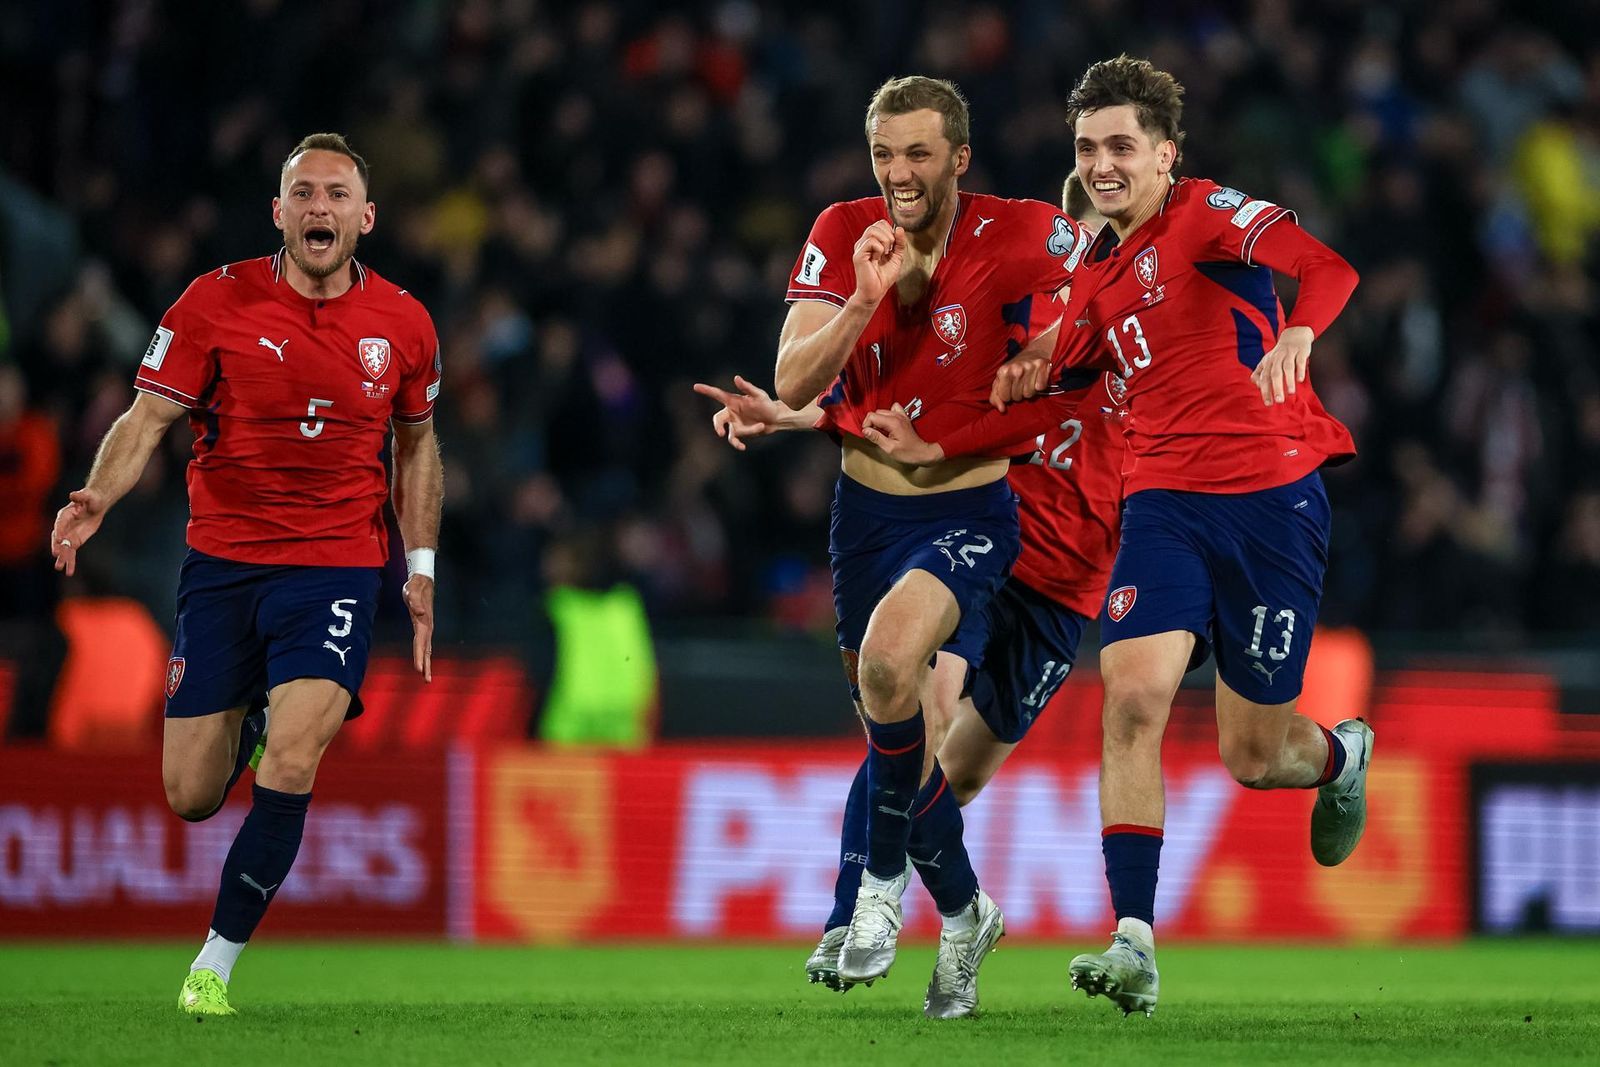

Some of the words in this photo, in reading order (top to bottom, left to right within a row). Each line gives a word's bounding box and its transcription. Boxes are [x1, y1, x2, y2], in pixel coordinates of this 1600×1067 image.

[1107, 314, 1152, 379] 13
[299, 398, 334, 438] 5
[328, 598, 358, 638] 5
[1243, 605, 1296, 661] 13
